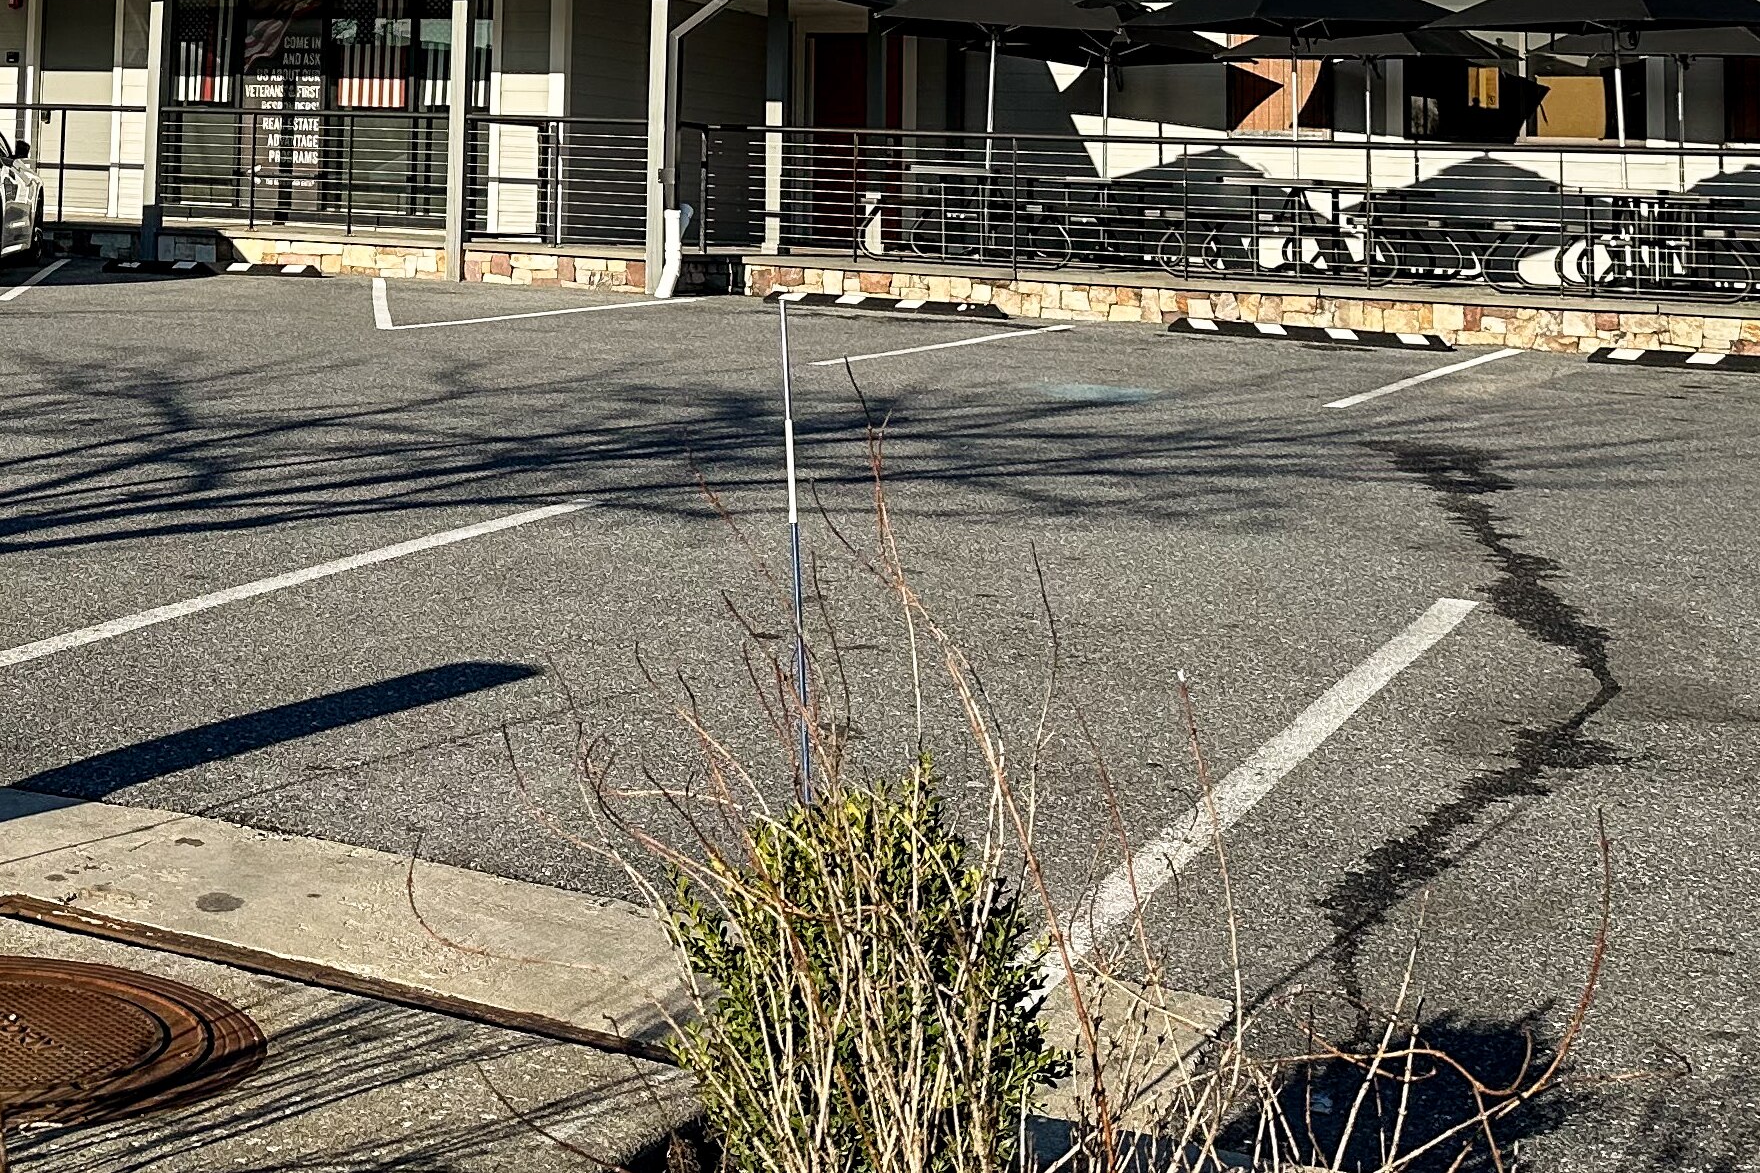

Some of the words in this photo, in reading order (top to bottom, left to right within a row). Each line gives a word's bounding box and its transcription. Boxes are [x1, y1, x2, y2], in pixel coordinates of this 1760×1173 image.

[284, 36, 310, 49] COME
[311, 37, 321, 49] IN
[282, 53, 301, 65] AND
[303, 53, 321, 65] ASK
[256, 68, 268, 82] US
[270, 68, 300, 82] ABOUT
[302, 69, 321, 82] OUR
[296, 86, 321, 98] FIRST
[262, 117, 284, 130] REAL
[267, 134, 319, 148] ADVANTAGE
[268, 150, 319, 164] PROGRAMS
